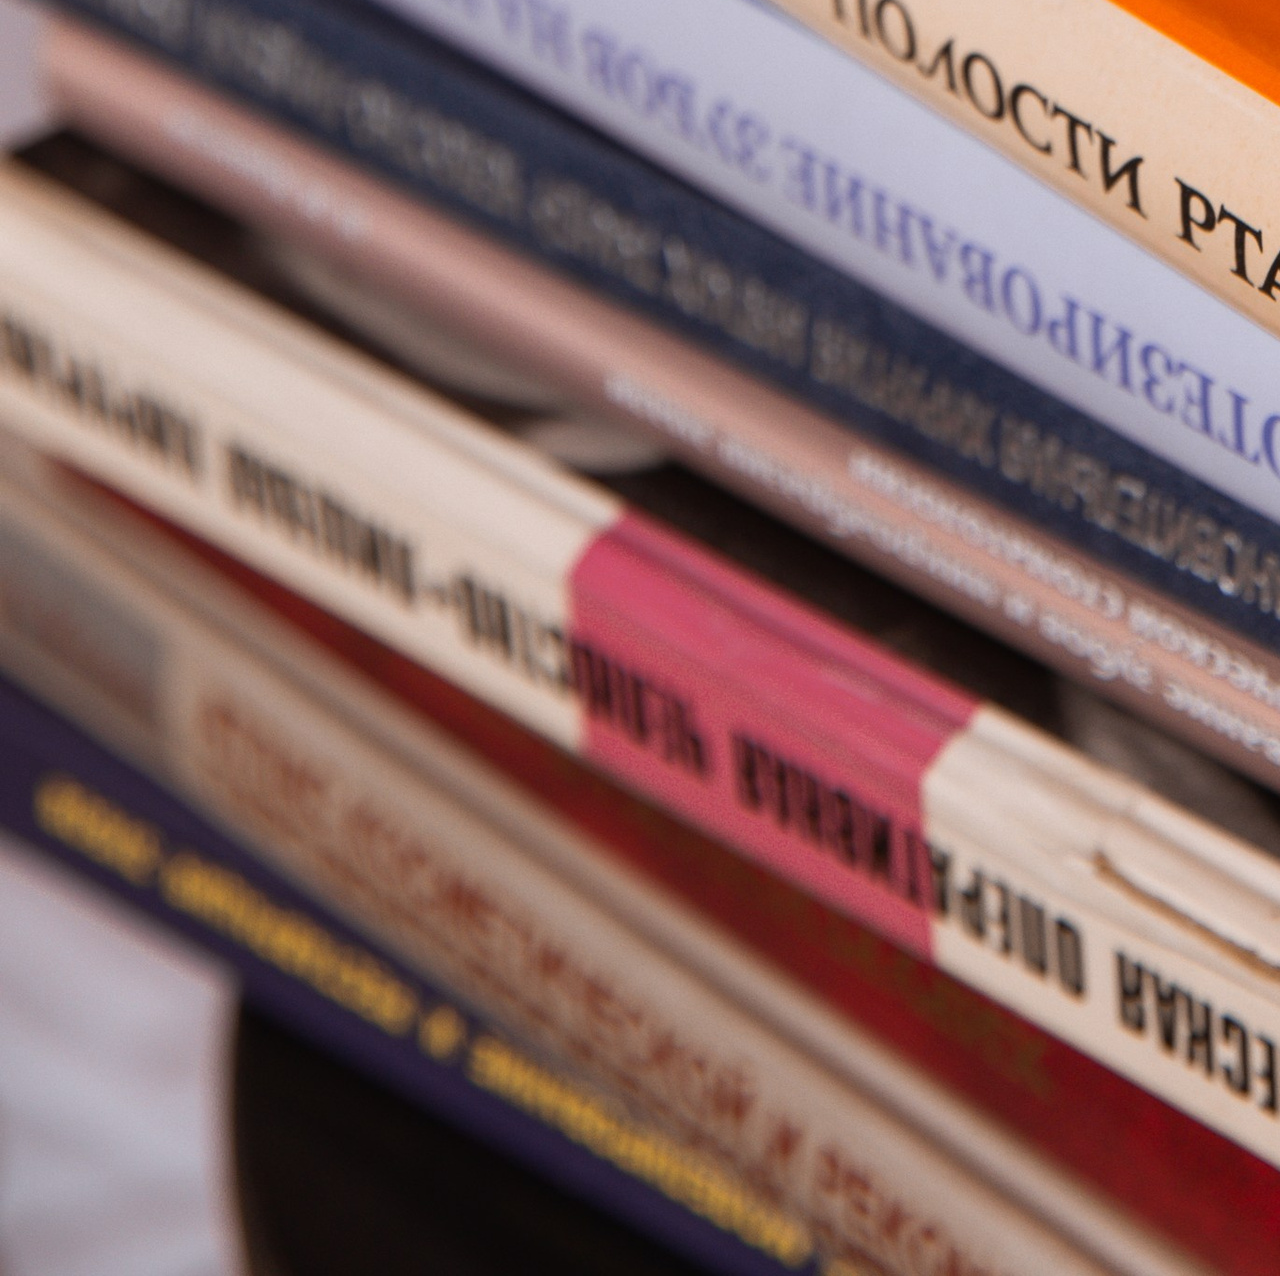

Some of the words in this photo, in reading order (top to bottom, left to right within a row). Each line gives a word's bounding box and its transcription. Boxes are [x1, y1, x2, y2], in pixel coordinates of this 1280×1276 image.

[580, 22, 773, 182] ЗУБОВ
[1038, 604, 1155, 696] зубов
[730, 727, 1086, 1002] ОПЕРАТИВНАЯ
